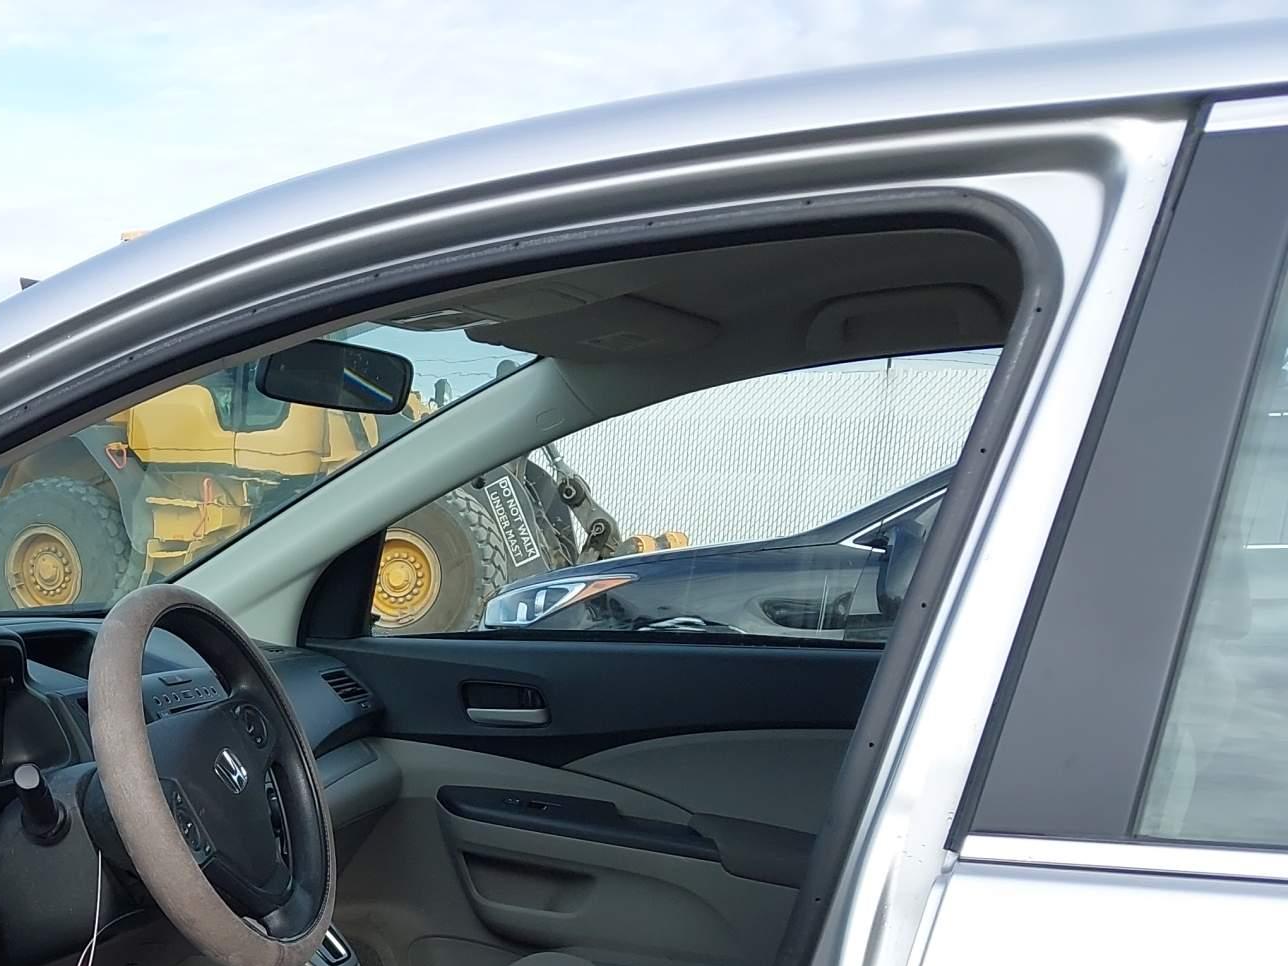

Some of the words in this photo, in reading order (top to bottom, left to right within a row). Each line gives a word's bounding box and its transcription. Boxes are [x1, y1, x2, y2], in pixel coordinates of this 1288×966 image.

[490, 491, 510, 529] UNDER
[505, 529, 523, 557] MAST
[498, 480, 511, 497] DO
[506, 499, 523, 522] NOT
[517, 523, 536, 557] WALK
